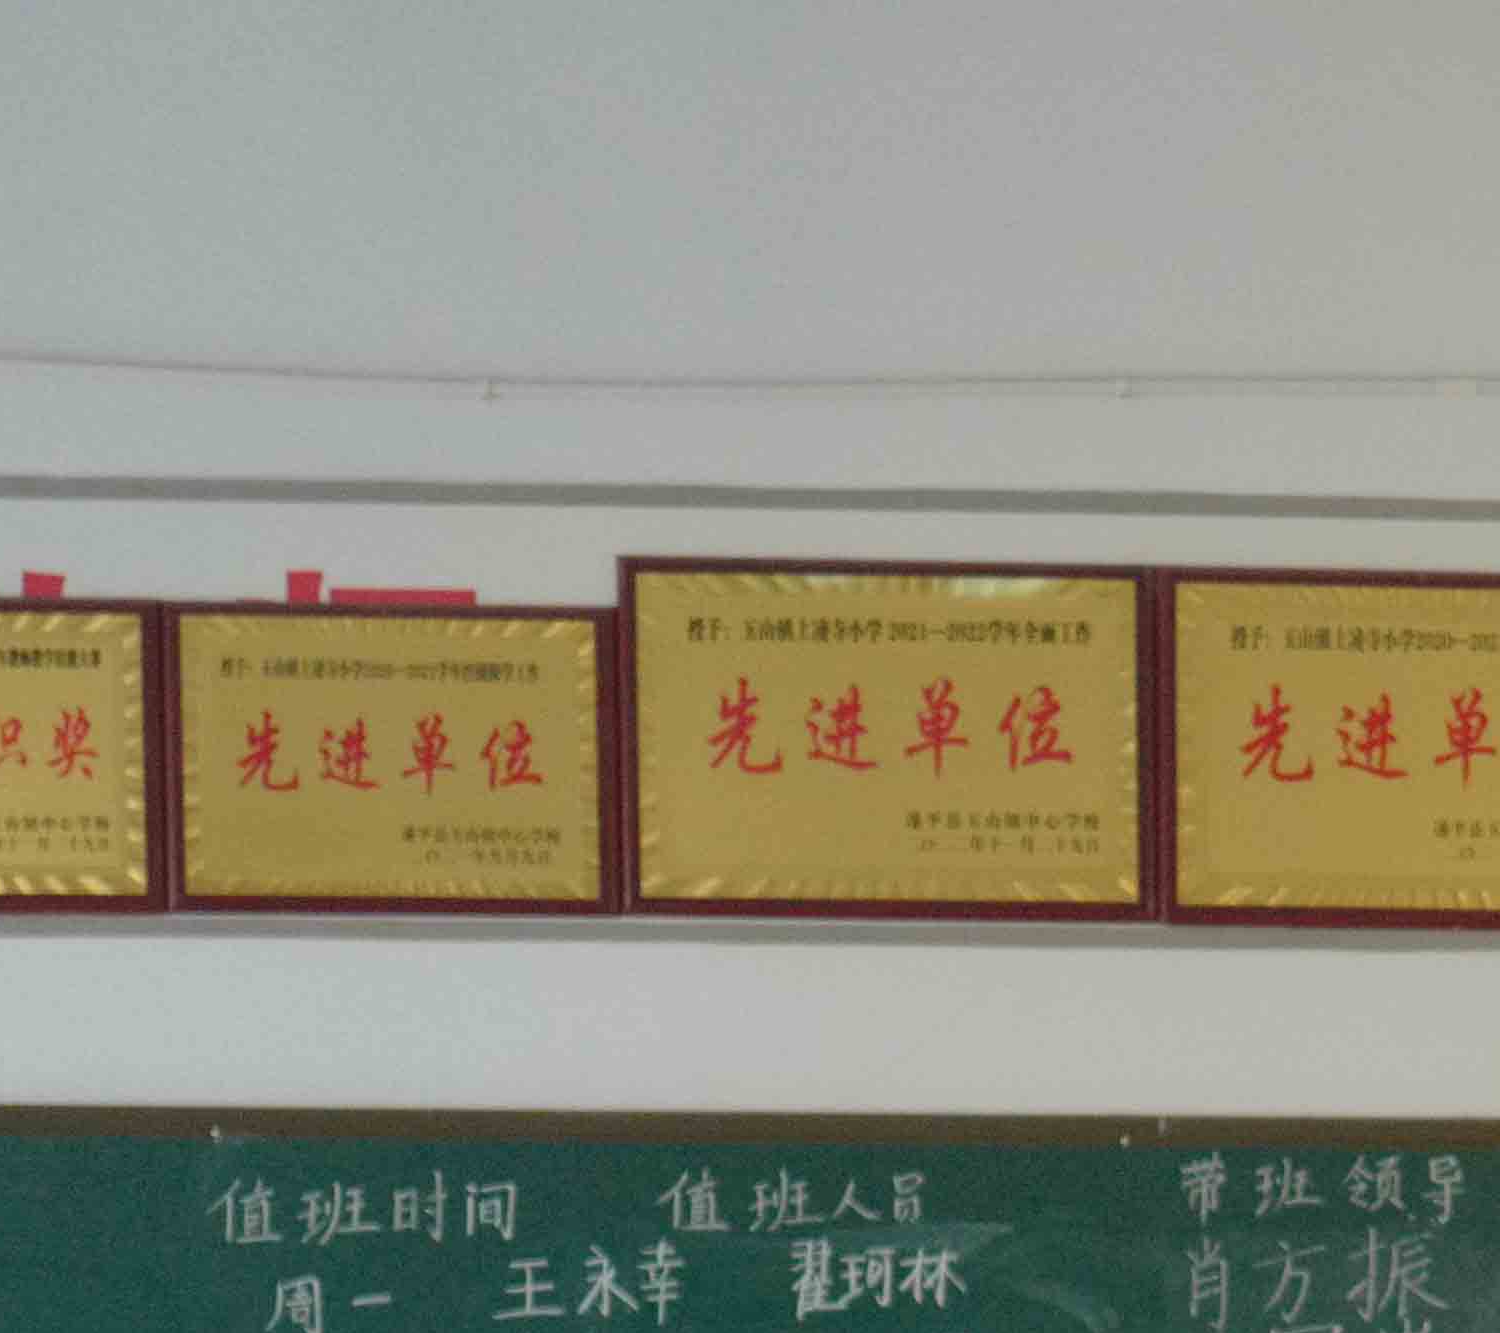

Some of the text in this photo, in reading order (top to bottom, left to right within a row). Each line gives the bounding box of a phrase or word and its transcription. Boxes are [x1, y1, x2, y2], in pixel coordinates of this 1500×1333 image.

[236, 709, 547, 794] 先进单位
[708, 676, 1074, 779] 先进单位
[206, 1169, 517, 1246] 值班时间
[656, 1166, 928, 1232] 值班人员
[1181, 1152, 1466, 1226] 带班领导
[492, 1238, 686, 1326] 王永幸
[1186, 1227, 1450, 1330] 肖方振
